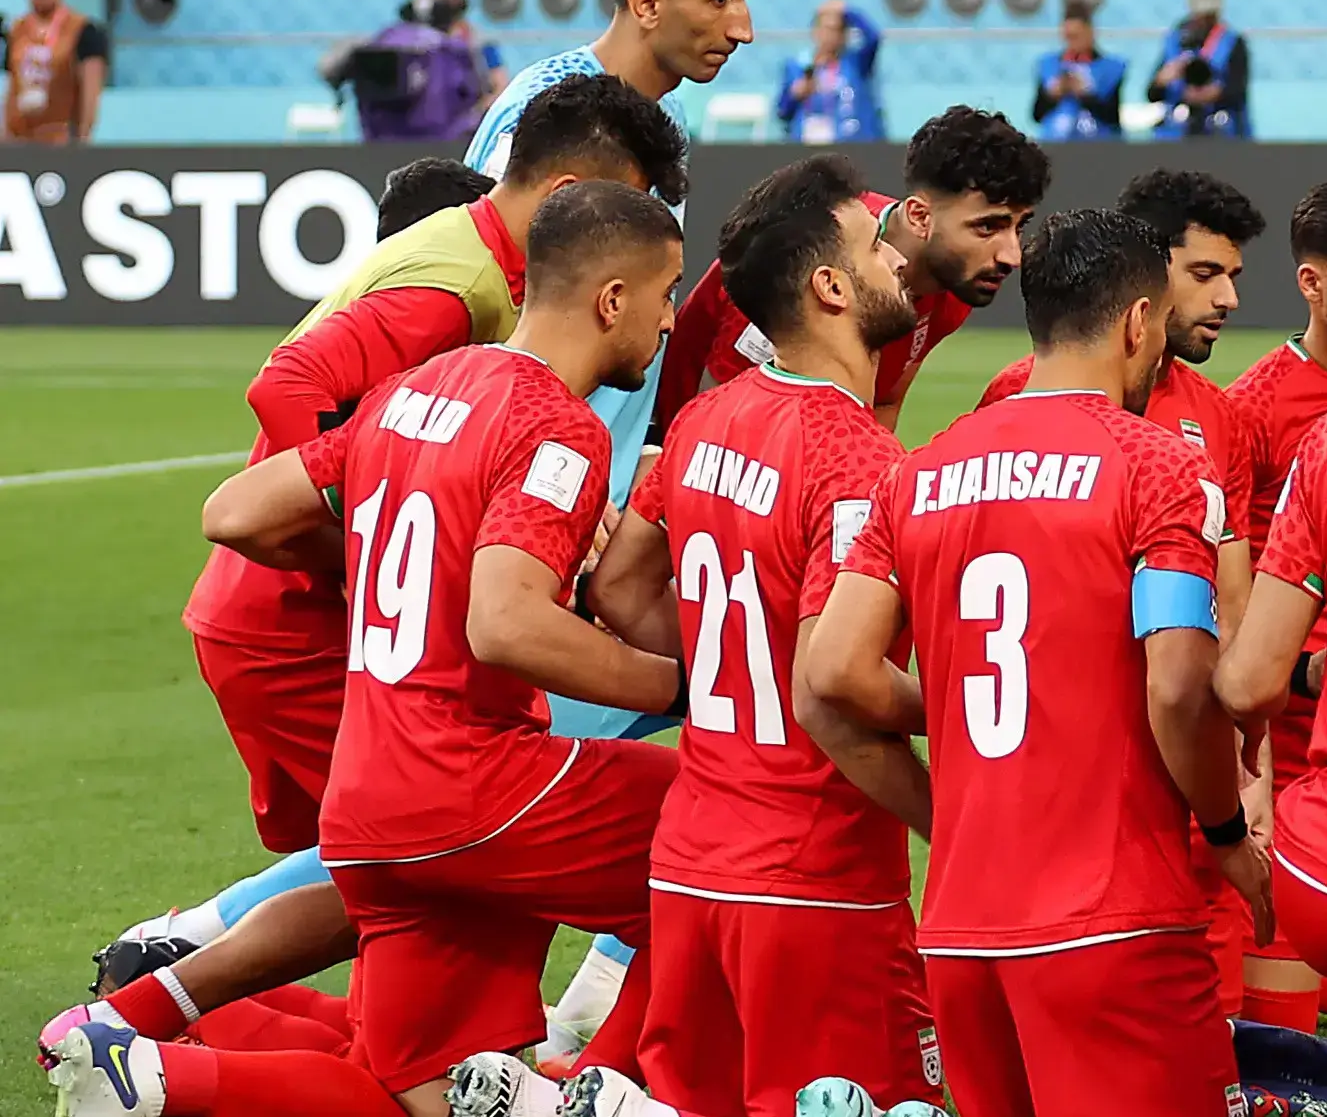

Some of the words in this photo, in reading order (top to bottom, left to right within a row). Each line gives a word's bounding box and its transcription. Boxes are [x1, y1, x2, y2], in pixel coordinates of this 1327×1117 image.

[351, 478, 436, 685] 19
[911, 451, 1101, 516] E.HAJISAFI
[681, 532, 787, 745] 21
[959, 552, 1030, 760] 3
